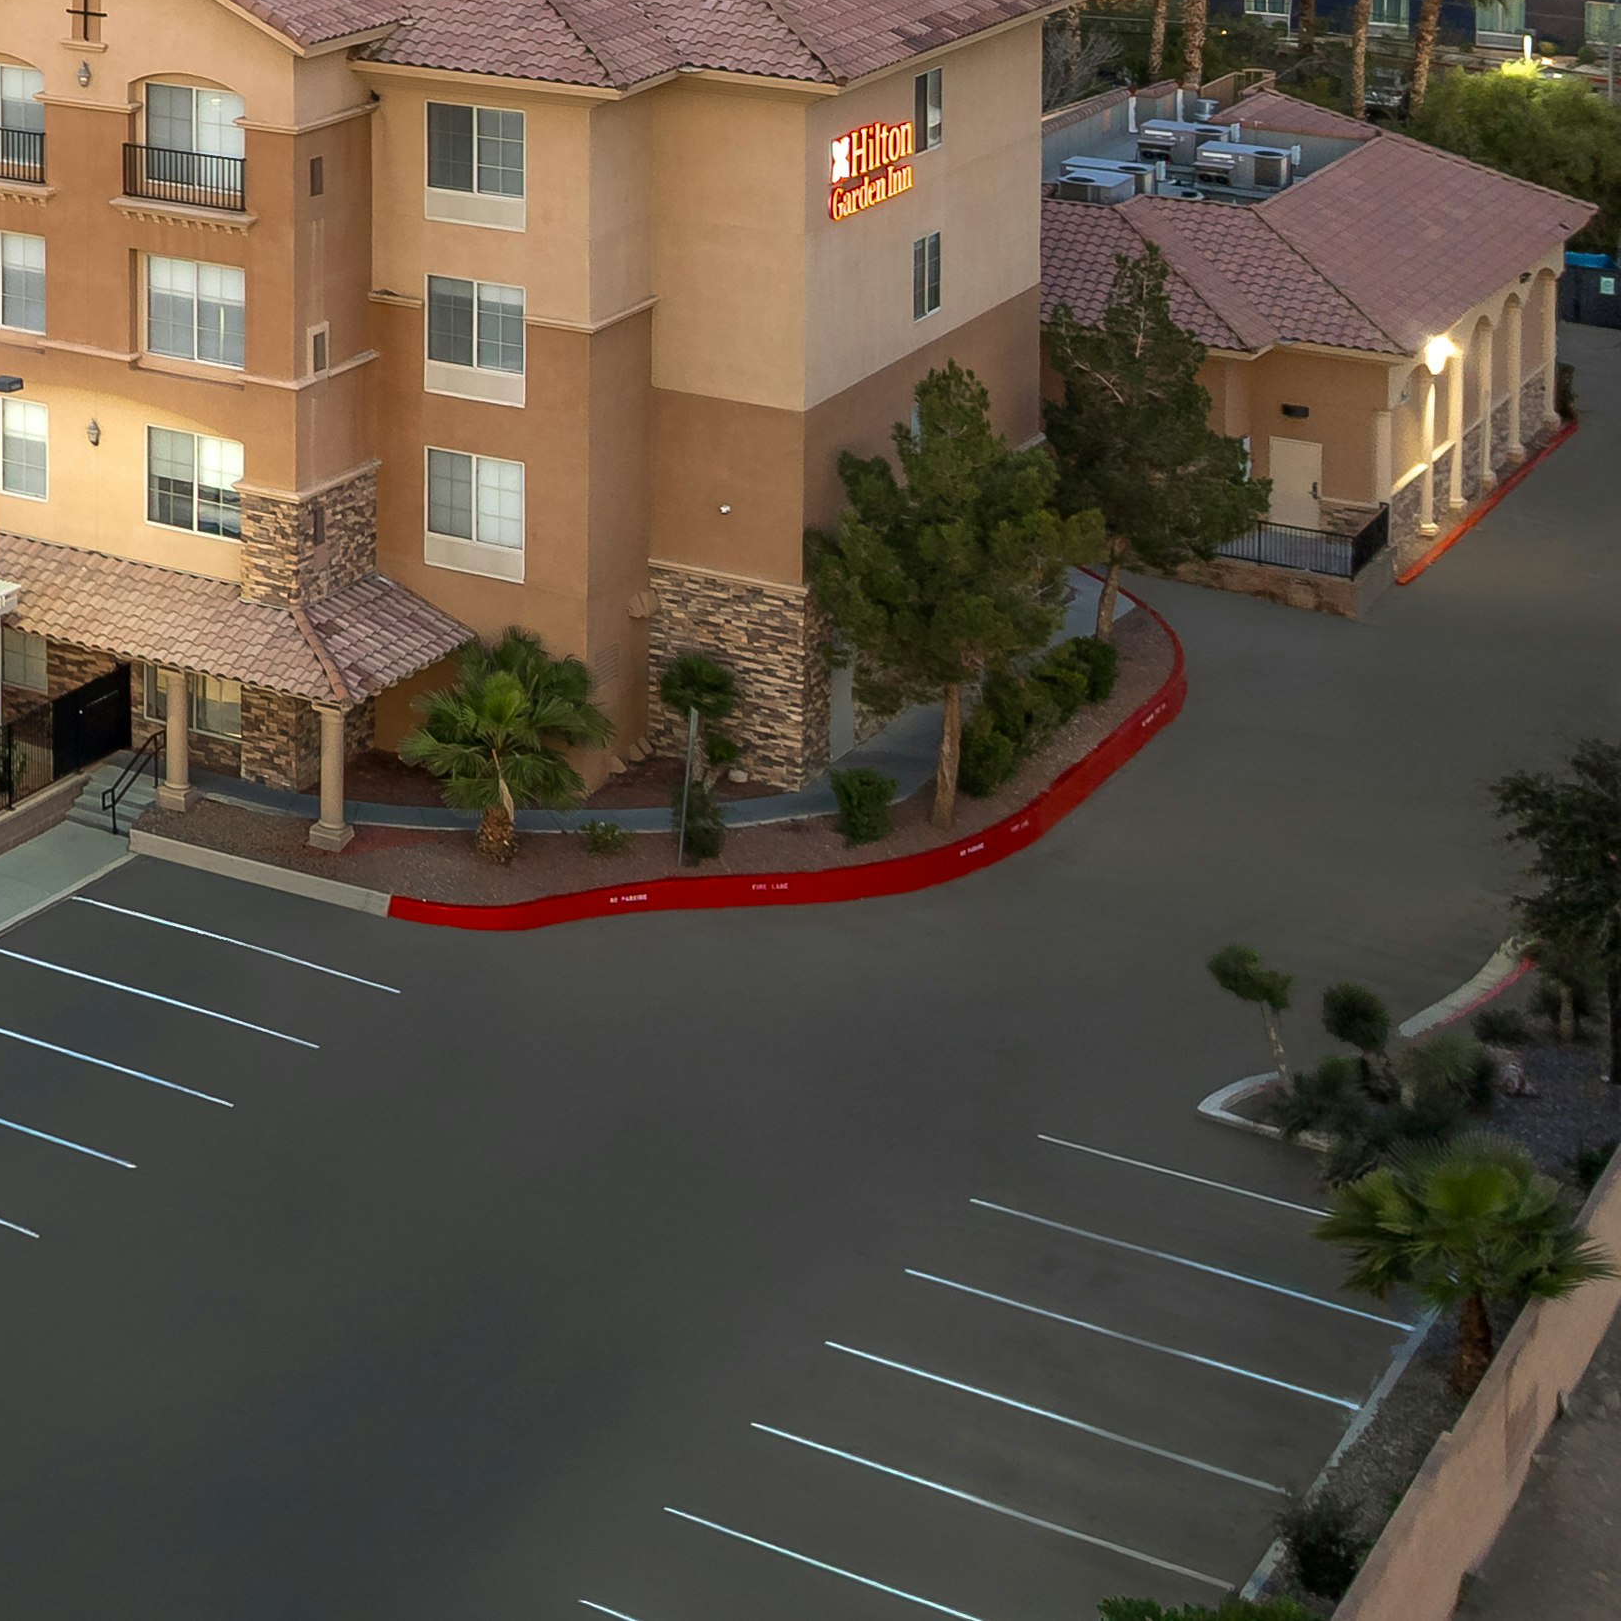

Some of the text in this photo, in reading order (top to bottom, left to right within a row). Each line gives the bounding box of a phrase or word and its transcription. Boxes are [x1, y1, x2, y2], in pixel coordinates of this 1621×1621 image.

[851, 122, 913, 177] Hilton
[831, 165, 913, 221] Garden Inn
